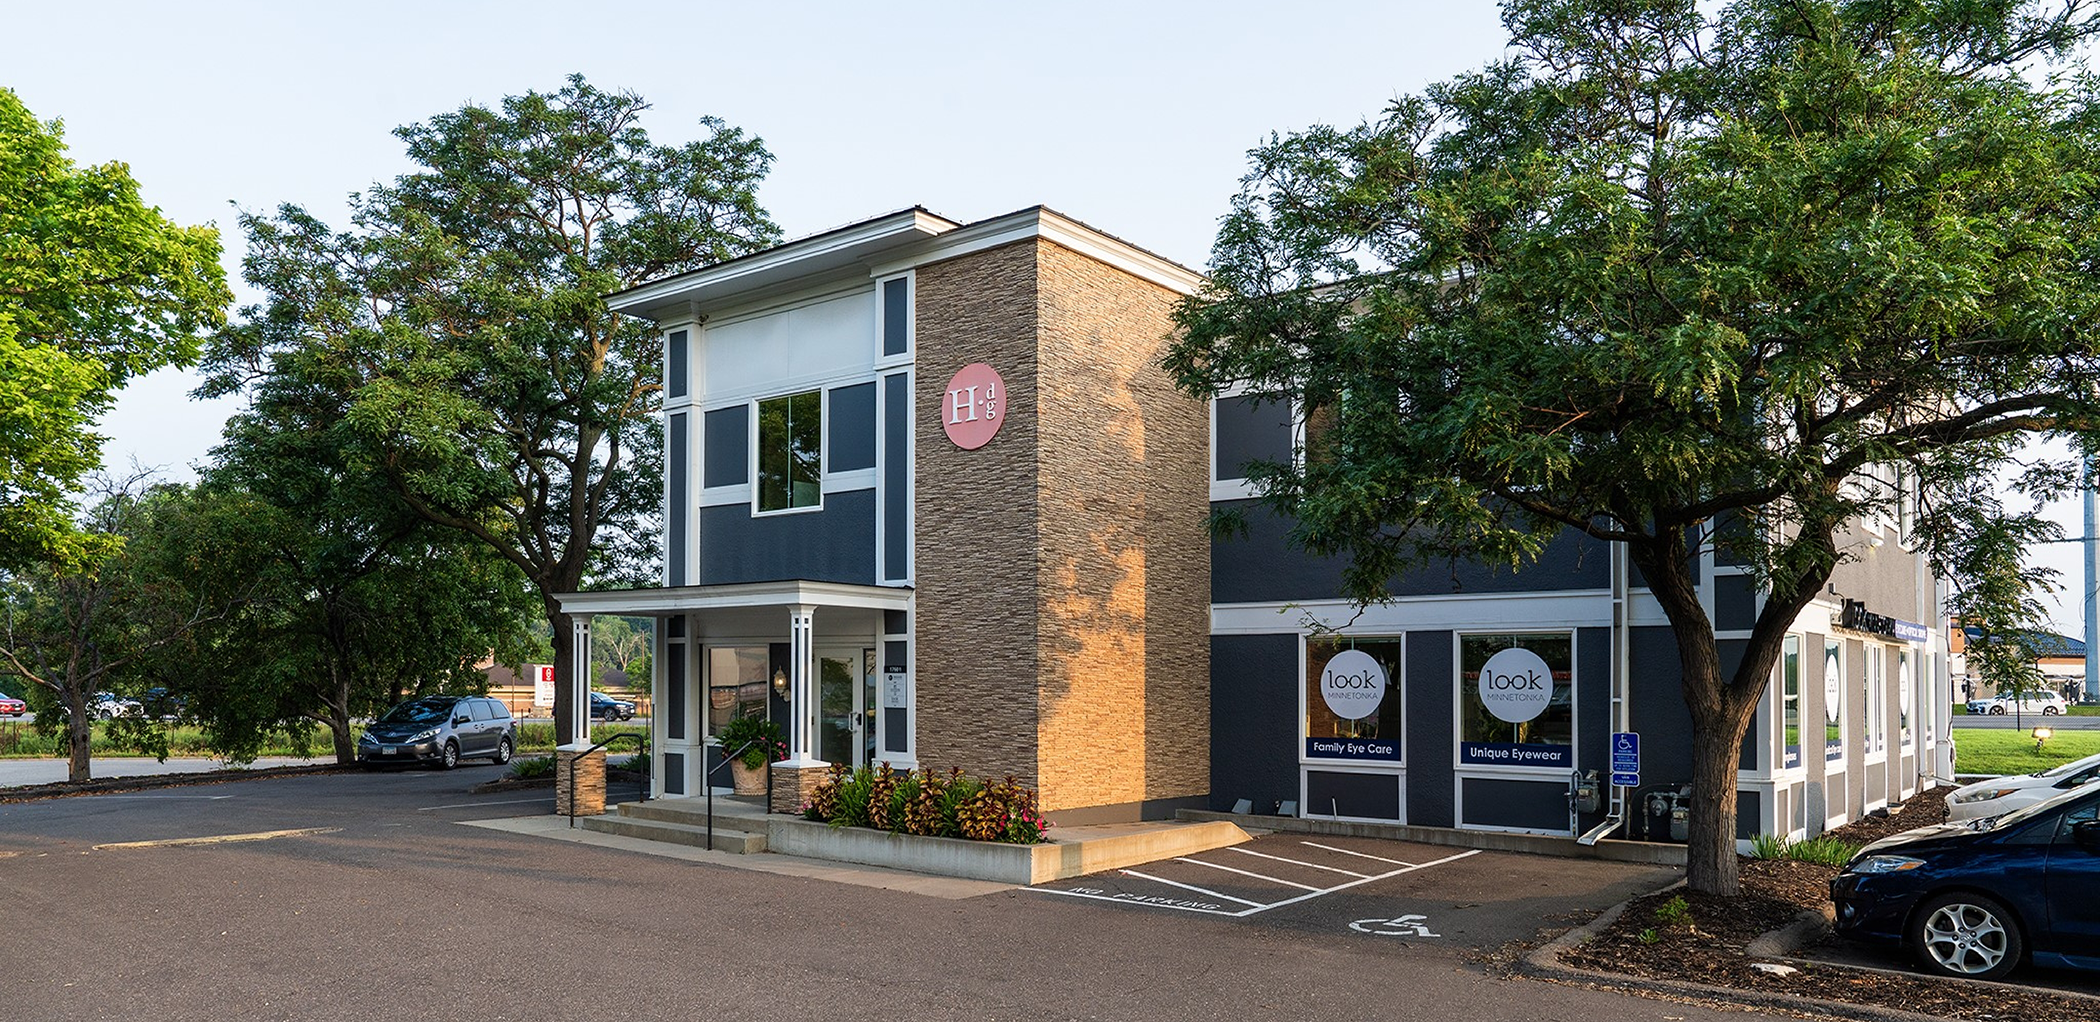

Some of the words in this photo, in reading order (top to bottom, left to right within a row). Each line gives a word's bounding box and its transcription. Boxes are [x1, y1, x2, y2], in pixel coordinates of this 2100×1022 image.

[1327, 669, 1377, 689] look
[1486, 669, 1543, 690] look
[1327, 692, 1379, 700] MINNETONKA
[1486, 693, 1546, 702] MINNETONKA
[1313, 741, 1345, 754] Family
[1347, 742, 1365, 755] Eye
[1367, 743, 1393, 754] Care
[1470, 747, 1509, 759] Unique
[1511, 748, 1562, 761] Eyewear
[1067, 887, 1104, 895] NO
[1113, 892, 1221, 910] PARKING
